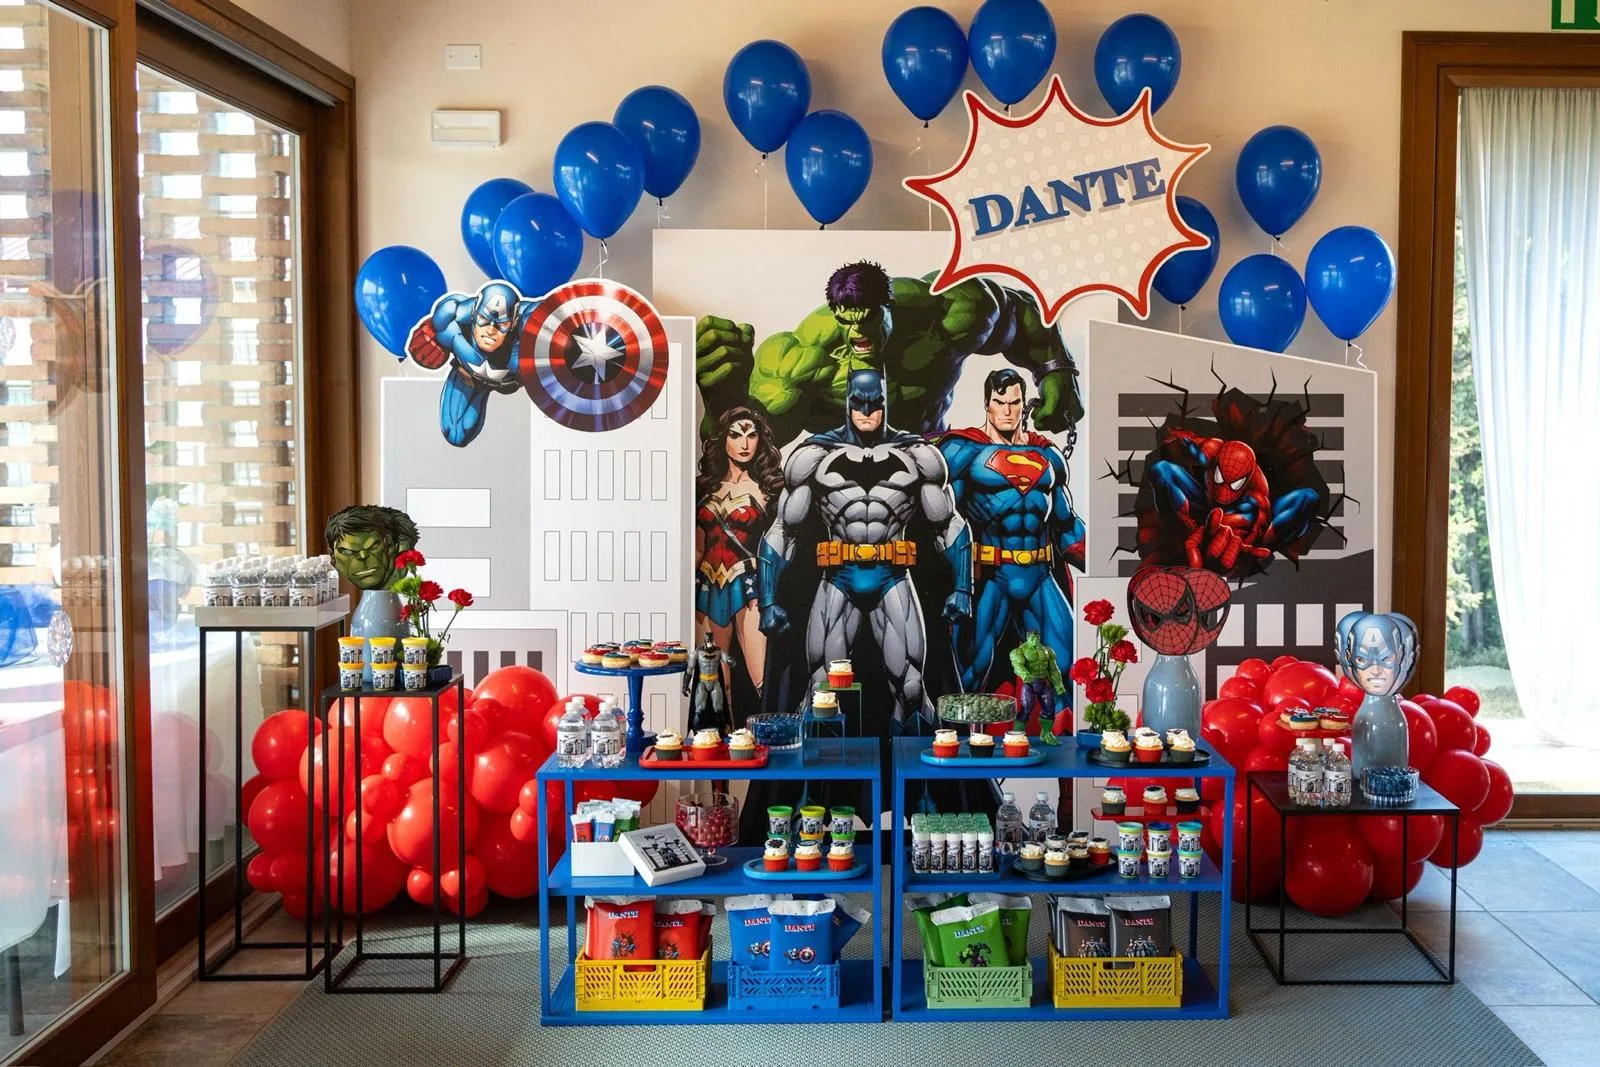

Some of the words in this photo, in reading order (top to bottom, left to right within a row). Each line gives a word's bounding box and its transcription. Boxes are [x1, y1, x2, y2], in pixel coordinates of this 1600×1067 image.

[967, 157, 1166, 238] DANTE
[608, 910, 639, 920] DANTE
[1125, 917, 1154, 927] DANTE
[785, 923, 815, 933] DANTE
[953, 924, 985, 939] DANTE
